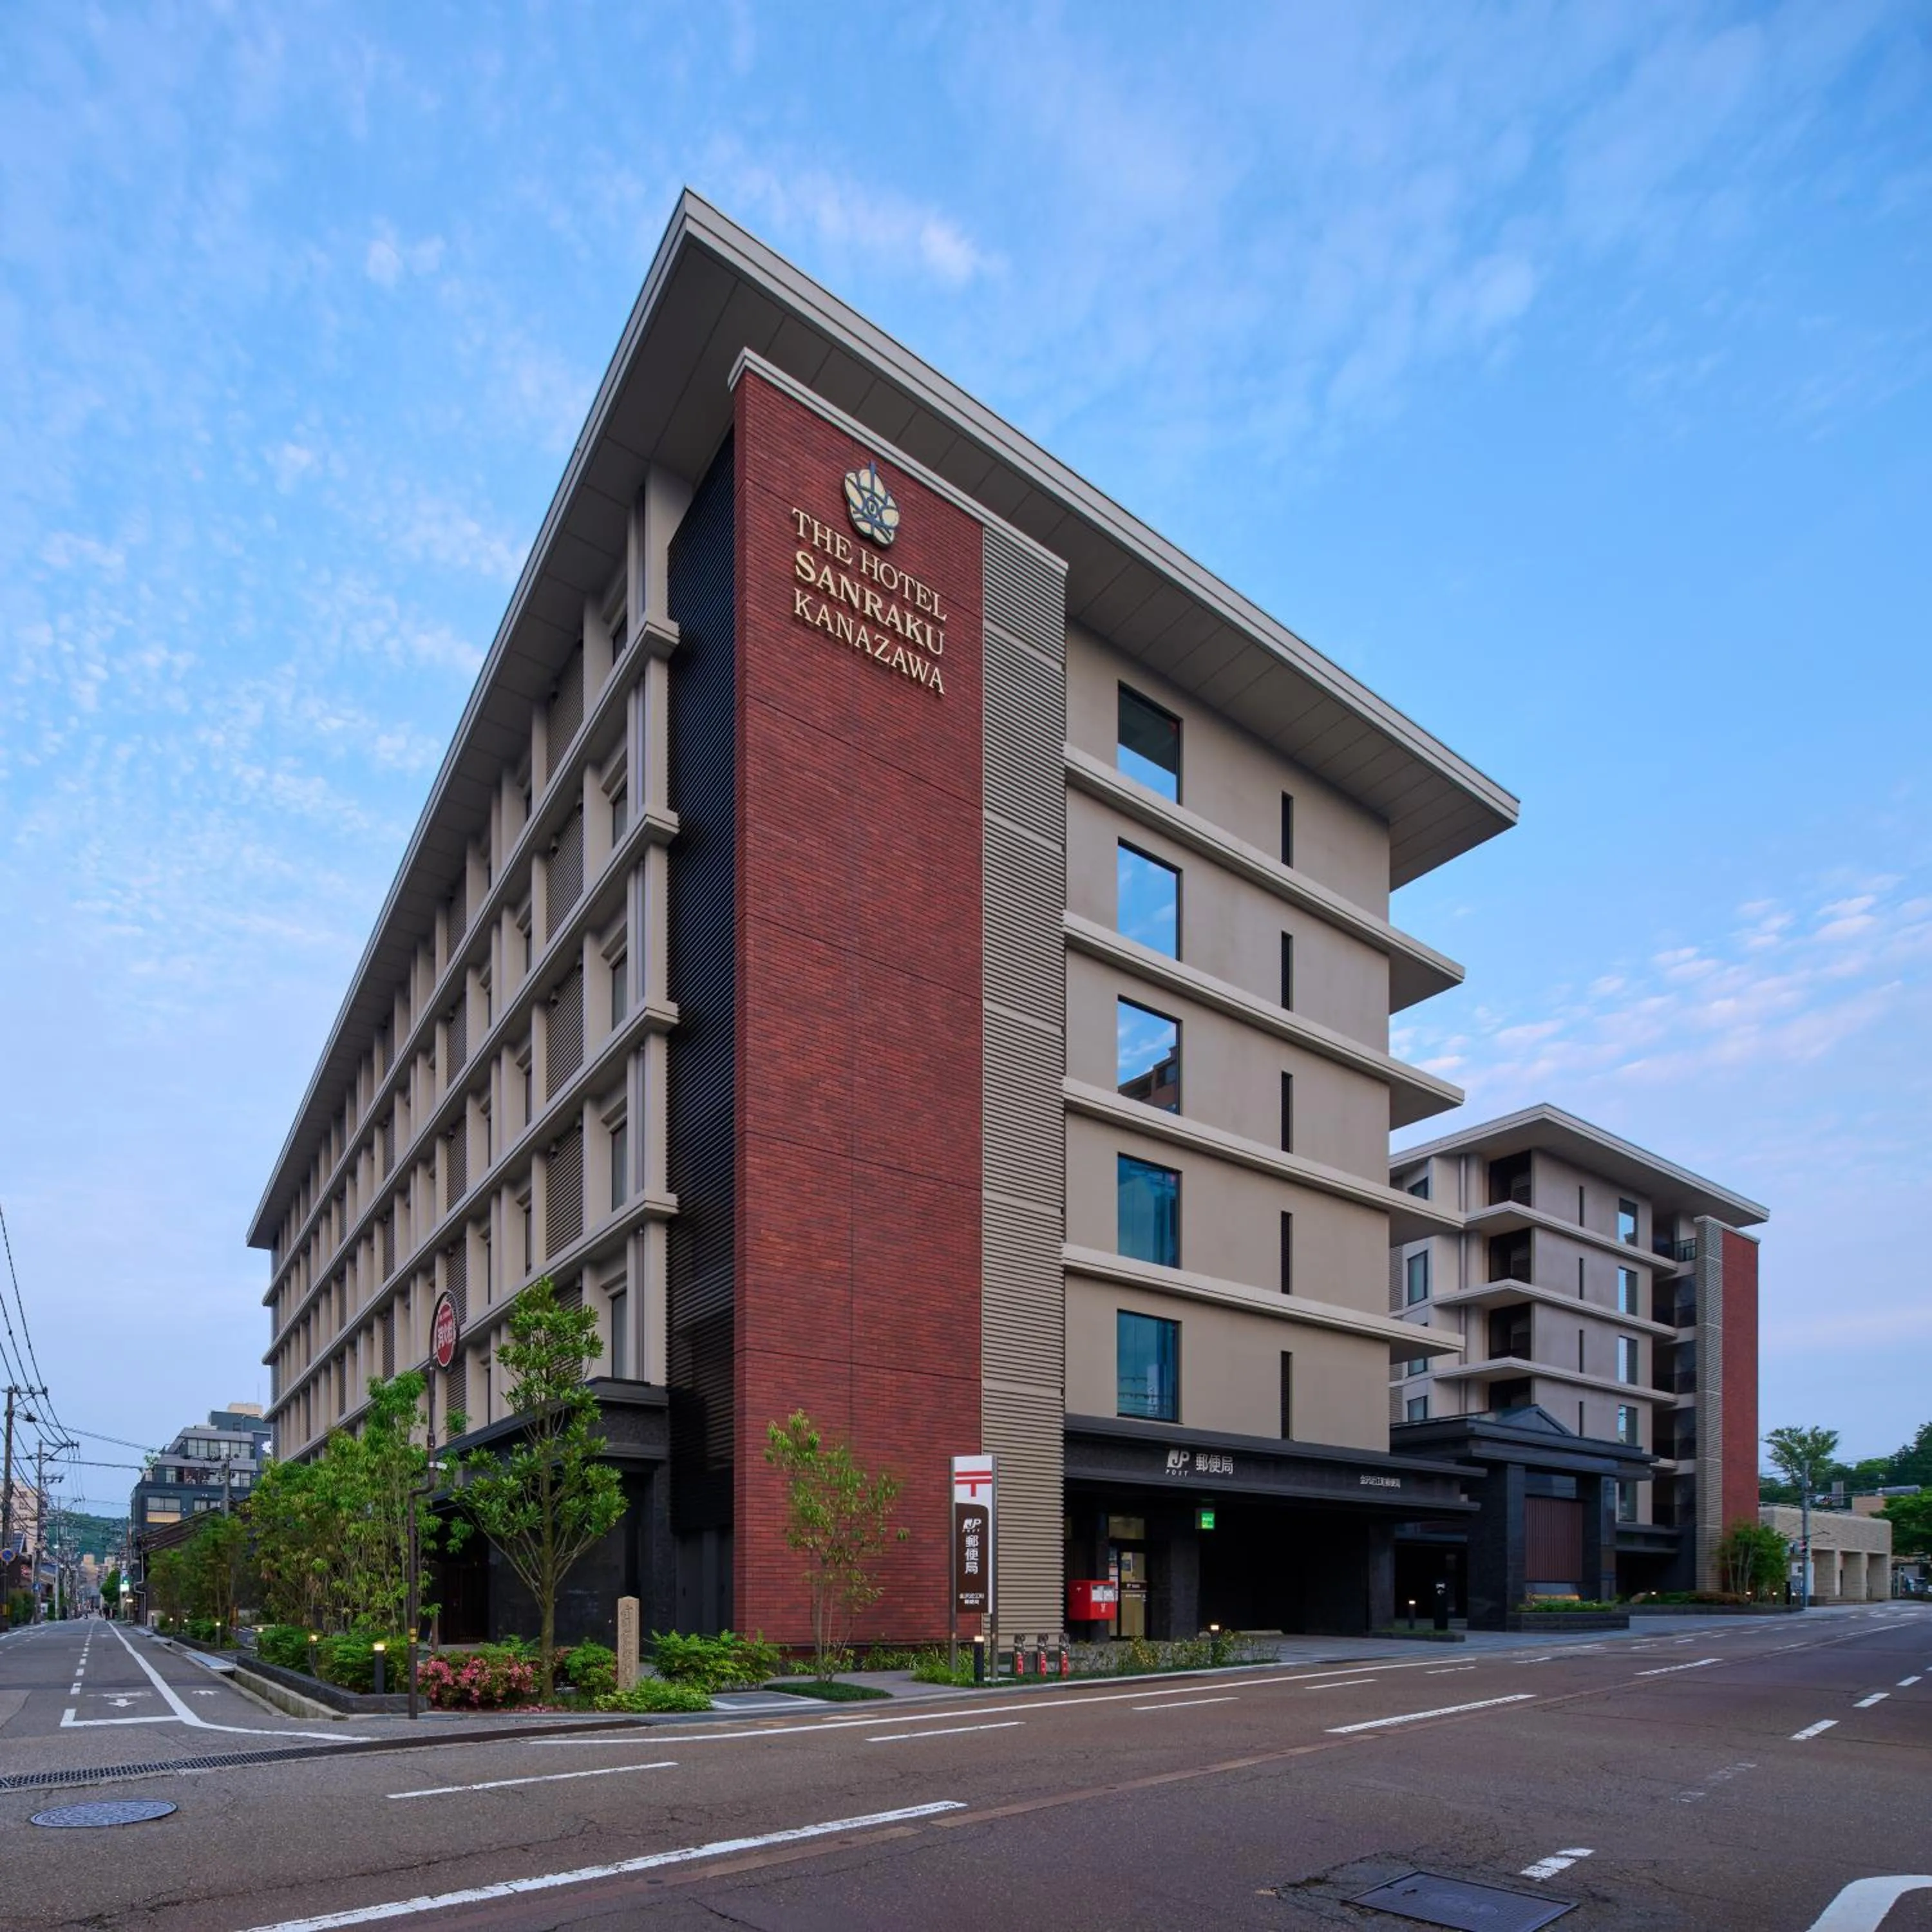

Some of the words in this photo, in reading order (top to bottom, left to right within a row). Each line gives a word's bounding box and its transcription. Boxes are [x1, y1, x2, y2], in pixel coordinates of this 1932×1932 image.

[792, 507, 853, 565] THE
[860, 547, 947, 622] HOTEL
[795, 551, 945, 656] SANRAKU
[793, 587, 945, 695] KANAZAWA
[1195, 1453, 1233, 1475] 郵便局
[964, 1535, 979, 1575] 郵便局
